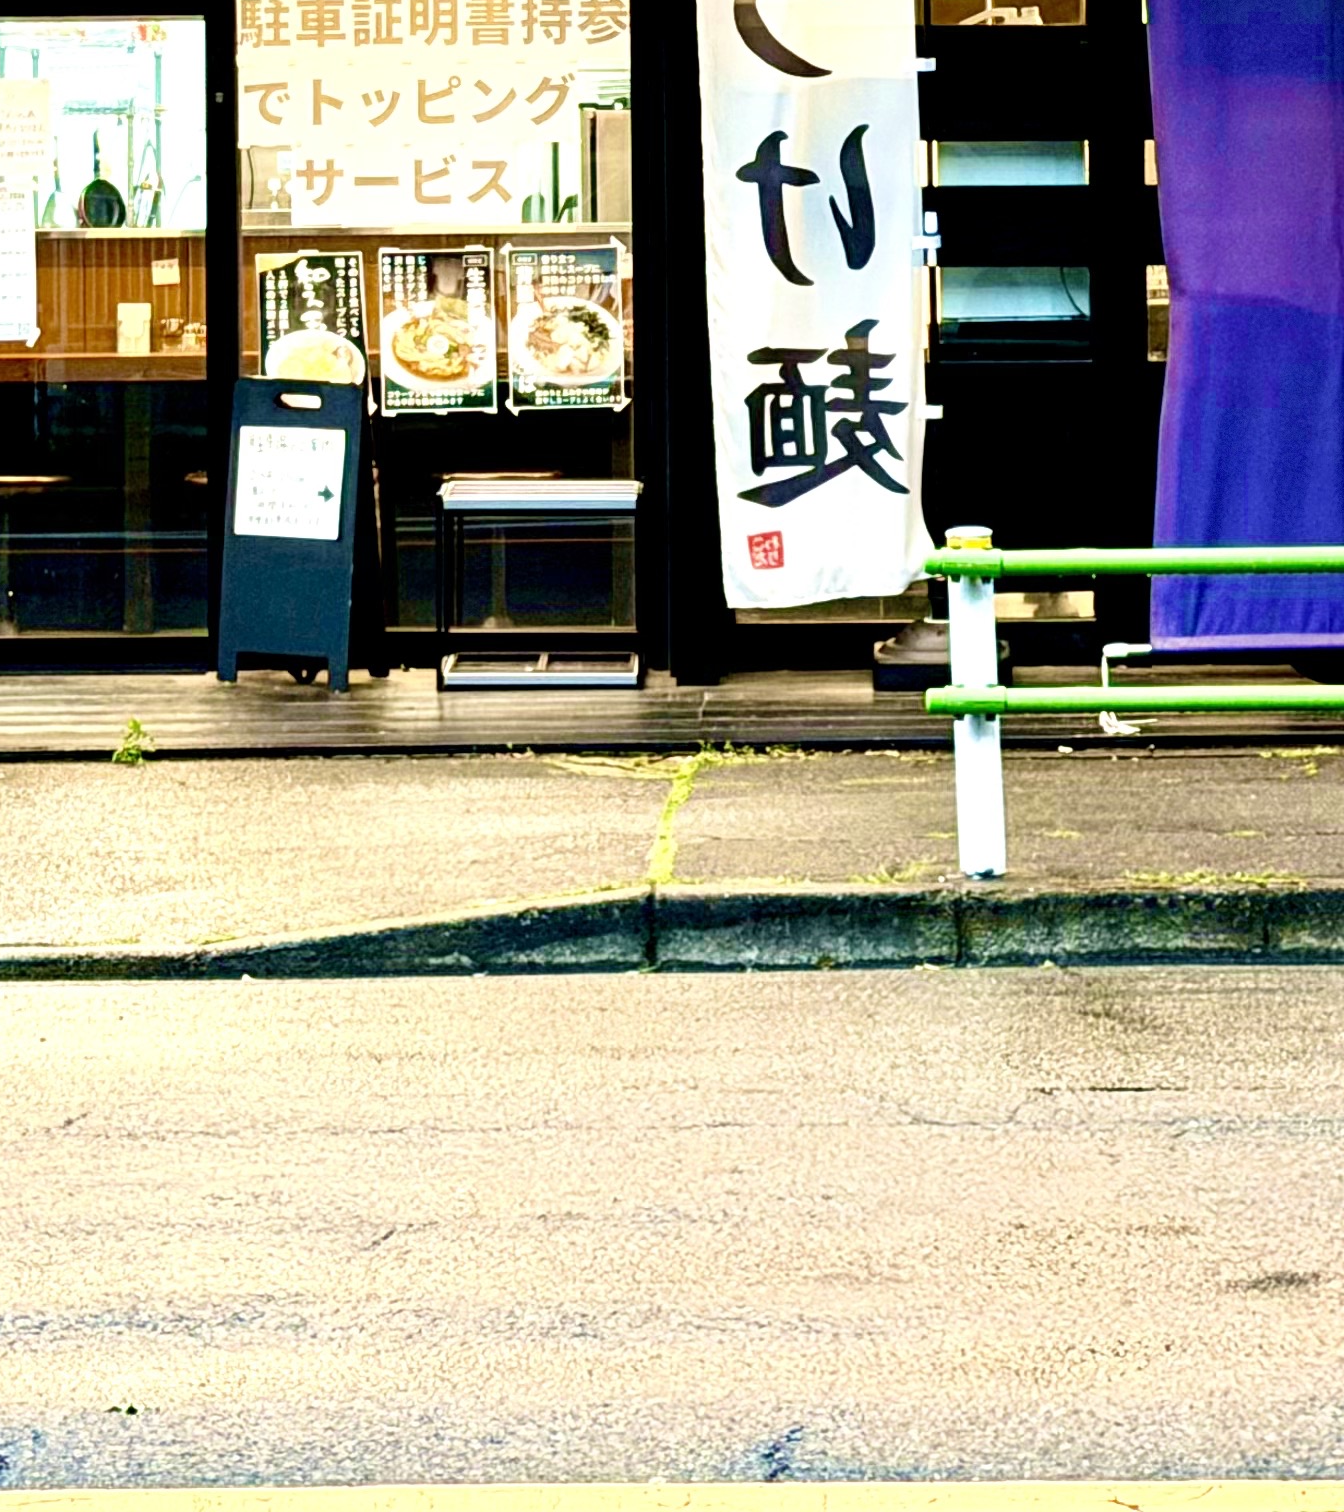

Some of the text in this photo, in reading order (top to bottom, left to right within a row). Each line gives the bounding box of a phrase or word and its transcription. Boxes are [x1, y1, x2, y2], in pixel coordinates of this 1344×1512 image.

[244, 73, 575, 127] でトッピング
[296, 154, 512, 206] サービス
